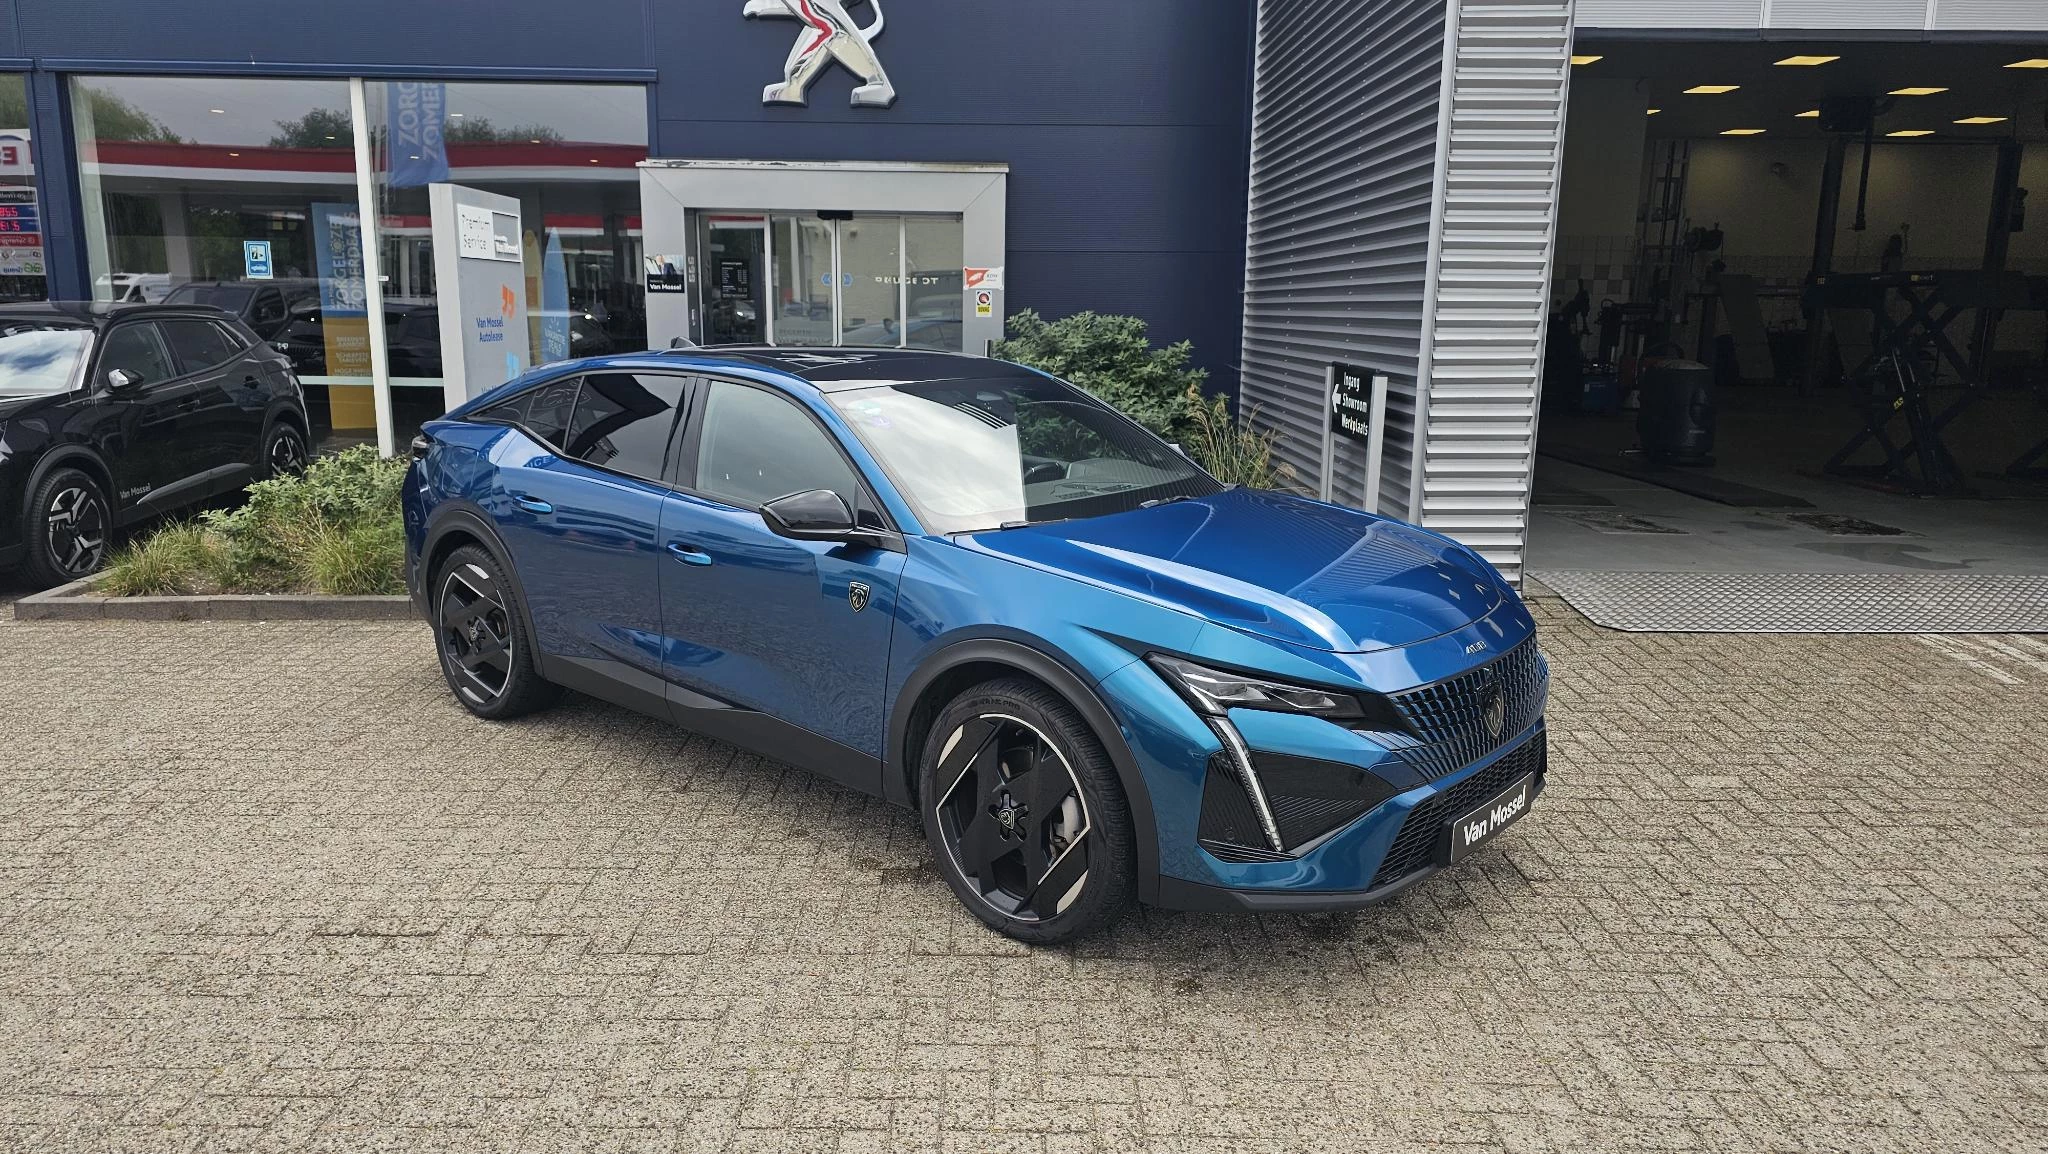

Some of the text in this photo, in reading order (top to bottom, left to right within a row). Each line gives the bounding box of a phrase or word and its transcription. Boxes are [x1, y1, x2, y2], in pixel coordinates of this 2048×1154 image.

[476, 315, 504, 329] Van Mossel
[479, 331, 504, 342] Autolease
[1343, 371, 1360, 392] Ingang
[1342, 392, 1368, 413] Showroom
[1341, 413, 1368, 436] Werkplaats
[1463, 784, 1527, 846] Van Mossel
